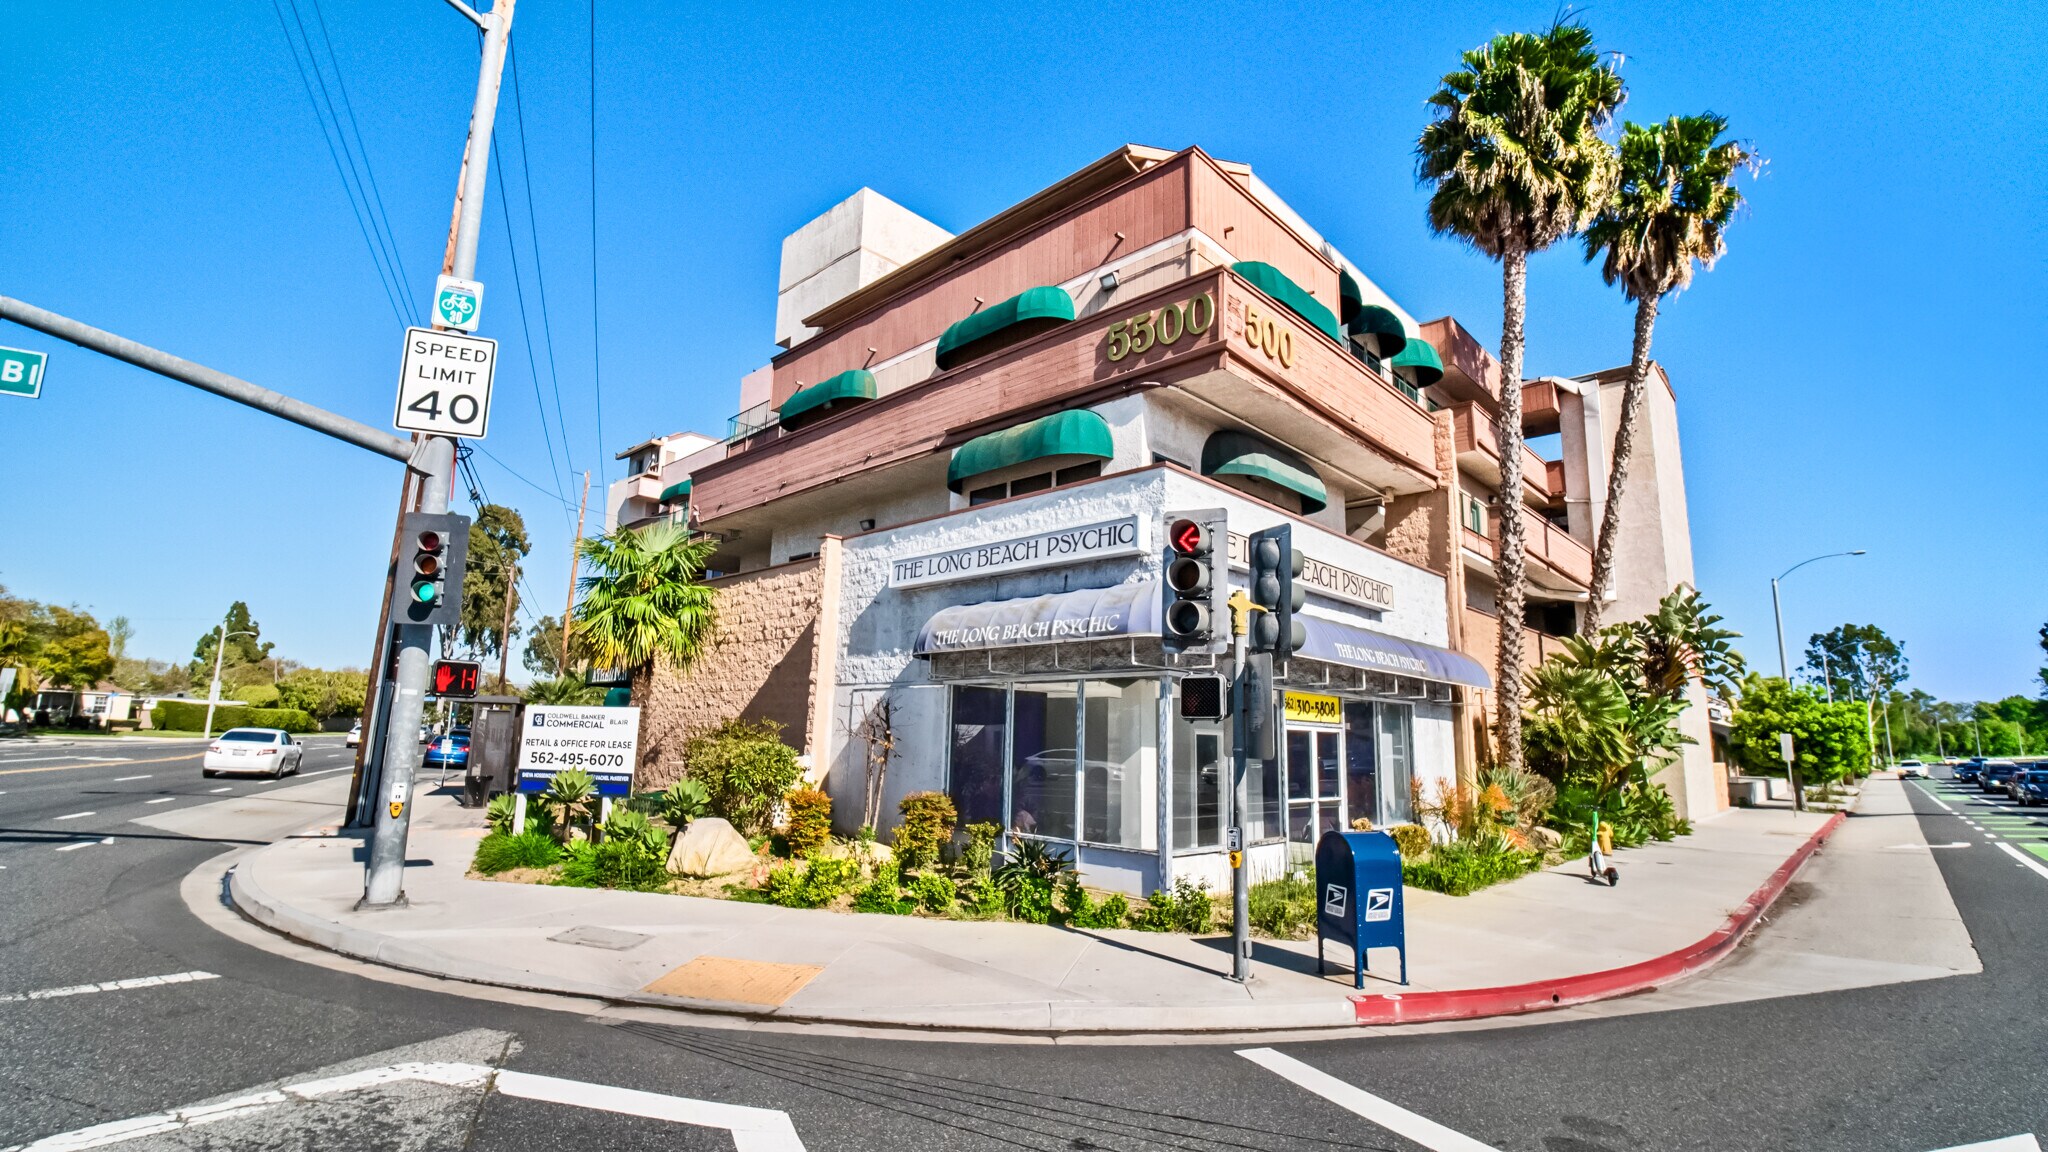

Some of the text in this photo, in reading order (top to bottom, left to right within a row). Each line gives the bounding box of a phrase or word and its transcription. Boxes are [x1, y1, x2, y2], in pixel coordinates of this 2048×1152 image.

[449, 310, 463, 324] 30
[1107, 292, 1215, 362] 5500
[414, 340, 488, 363] SPEED
[418, 364, 477, 385] LIMIT
[407, 390, 479, 425] 40
[894, 523, 1135, 581] THE LONG BEACH PSYCHIC
[1302, 559, 1390, 605] EACH PSYCHIC
[936, 614, 1120, 645] THE LONG BEACH PSYCHIC
[1334, 642, 1427, 673] THE LONG BEACH PSYCHIC
[546, 719, 605, 729] COMMERCIAL
[609, 718, 629, 726] BLAIR
[525, 738, 632, 750] RETAIL & OFFICE FOR LEASE
[530, 752, 624, 767] 562-495-6070
